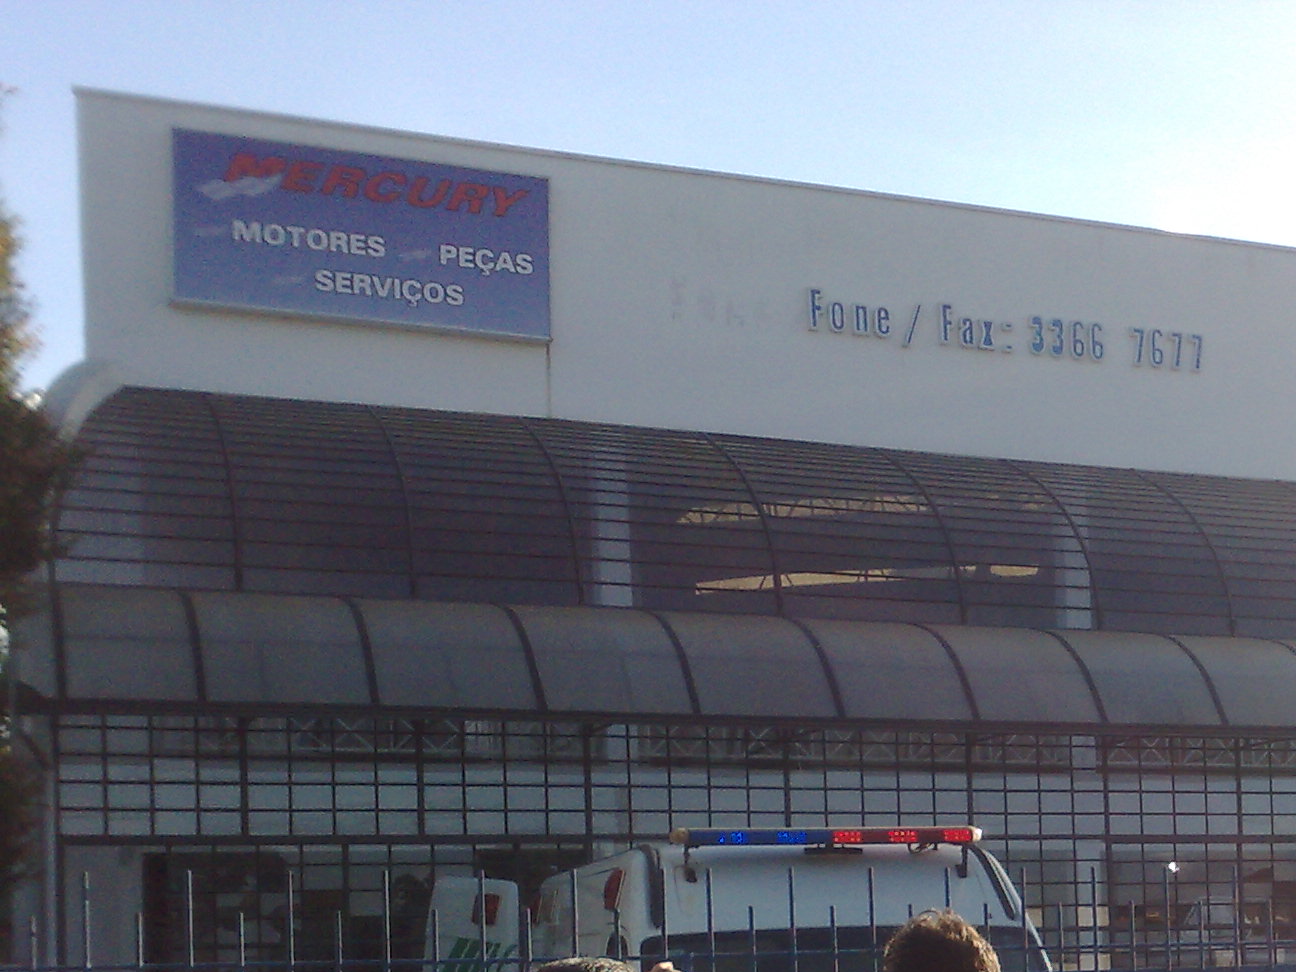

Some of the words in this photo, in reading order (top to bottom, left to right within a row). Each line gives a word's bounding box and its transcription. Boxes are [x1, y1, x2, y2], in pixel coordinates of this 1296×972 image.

[224, 153, 531, 218] MERCURY
[231, 219, 387, 258] MOTORES
[439, 243, 534, 276] PEÇAS
[315, 269, 465, 308] SERVIÇOS
[808, 288, 892, 338] Fone
[902, 303, 922, 349] /
[940, 302, 1014, 353] Fax:
[1028, 314, 1105, 363] 3366
[1129, 324, 1203, 373] 7677
